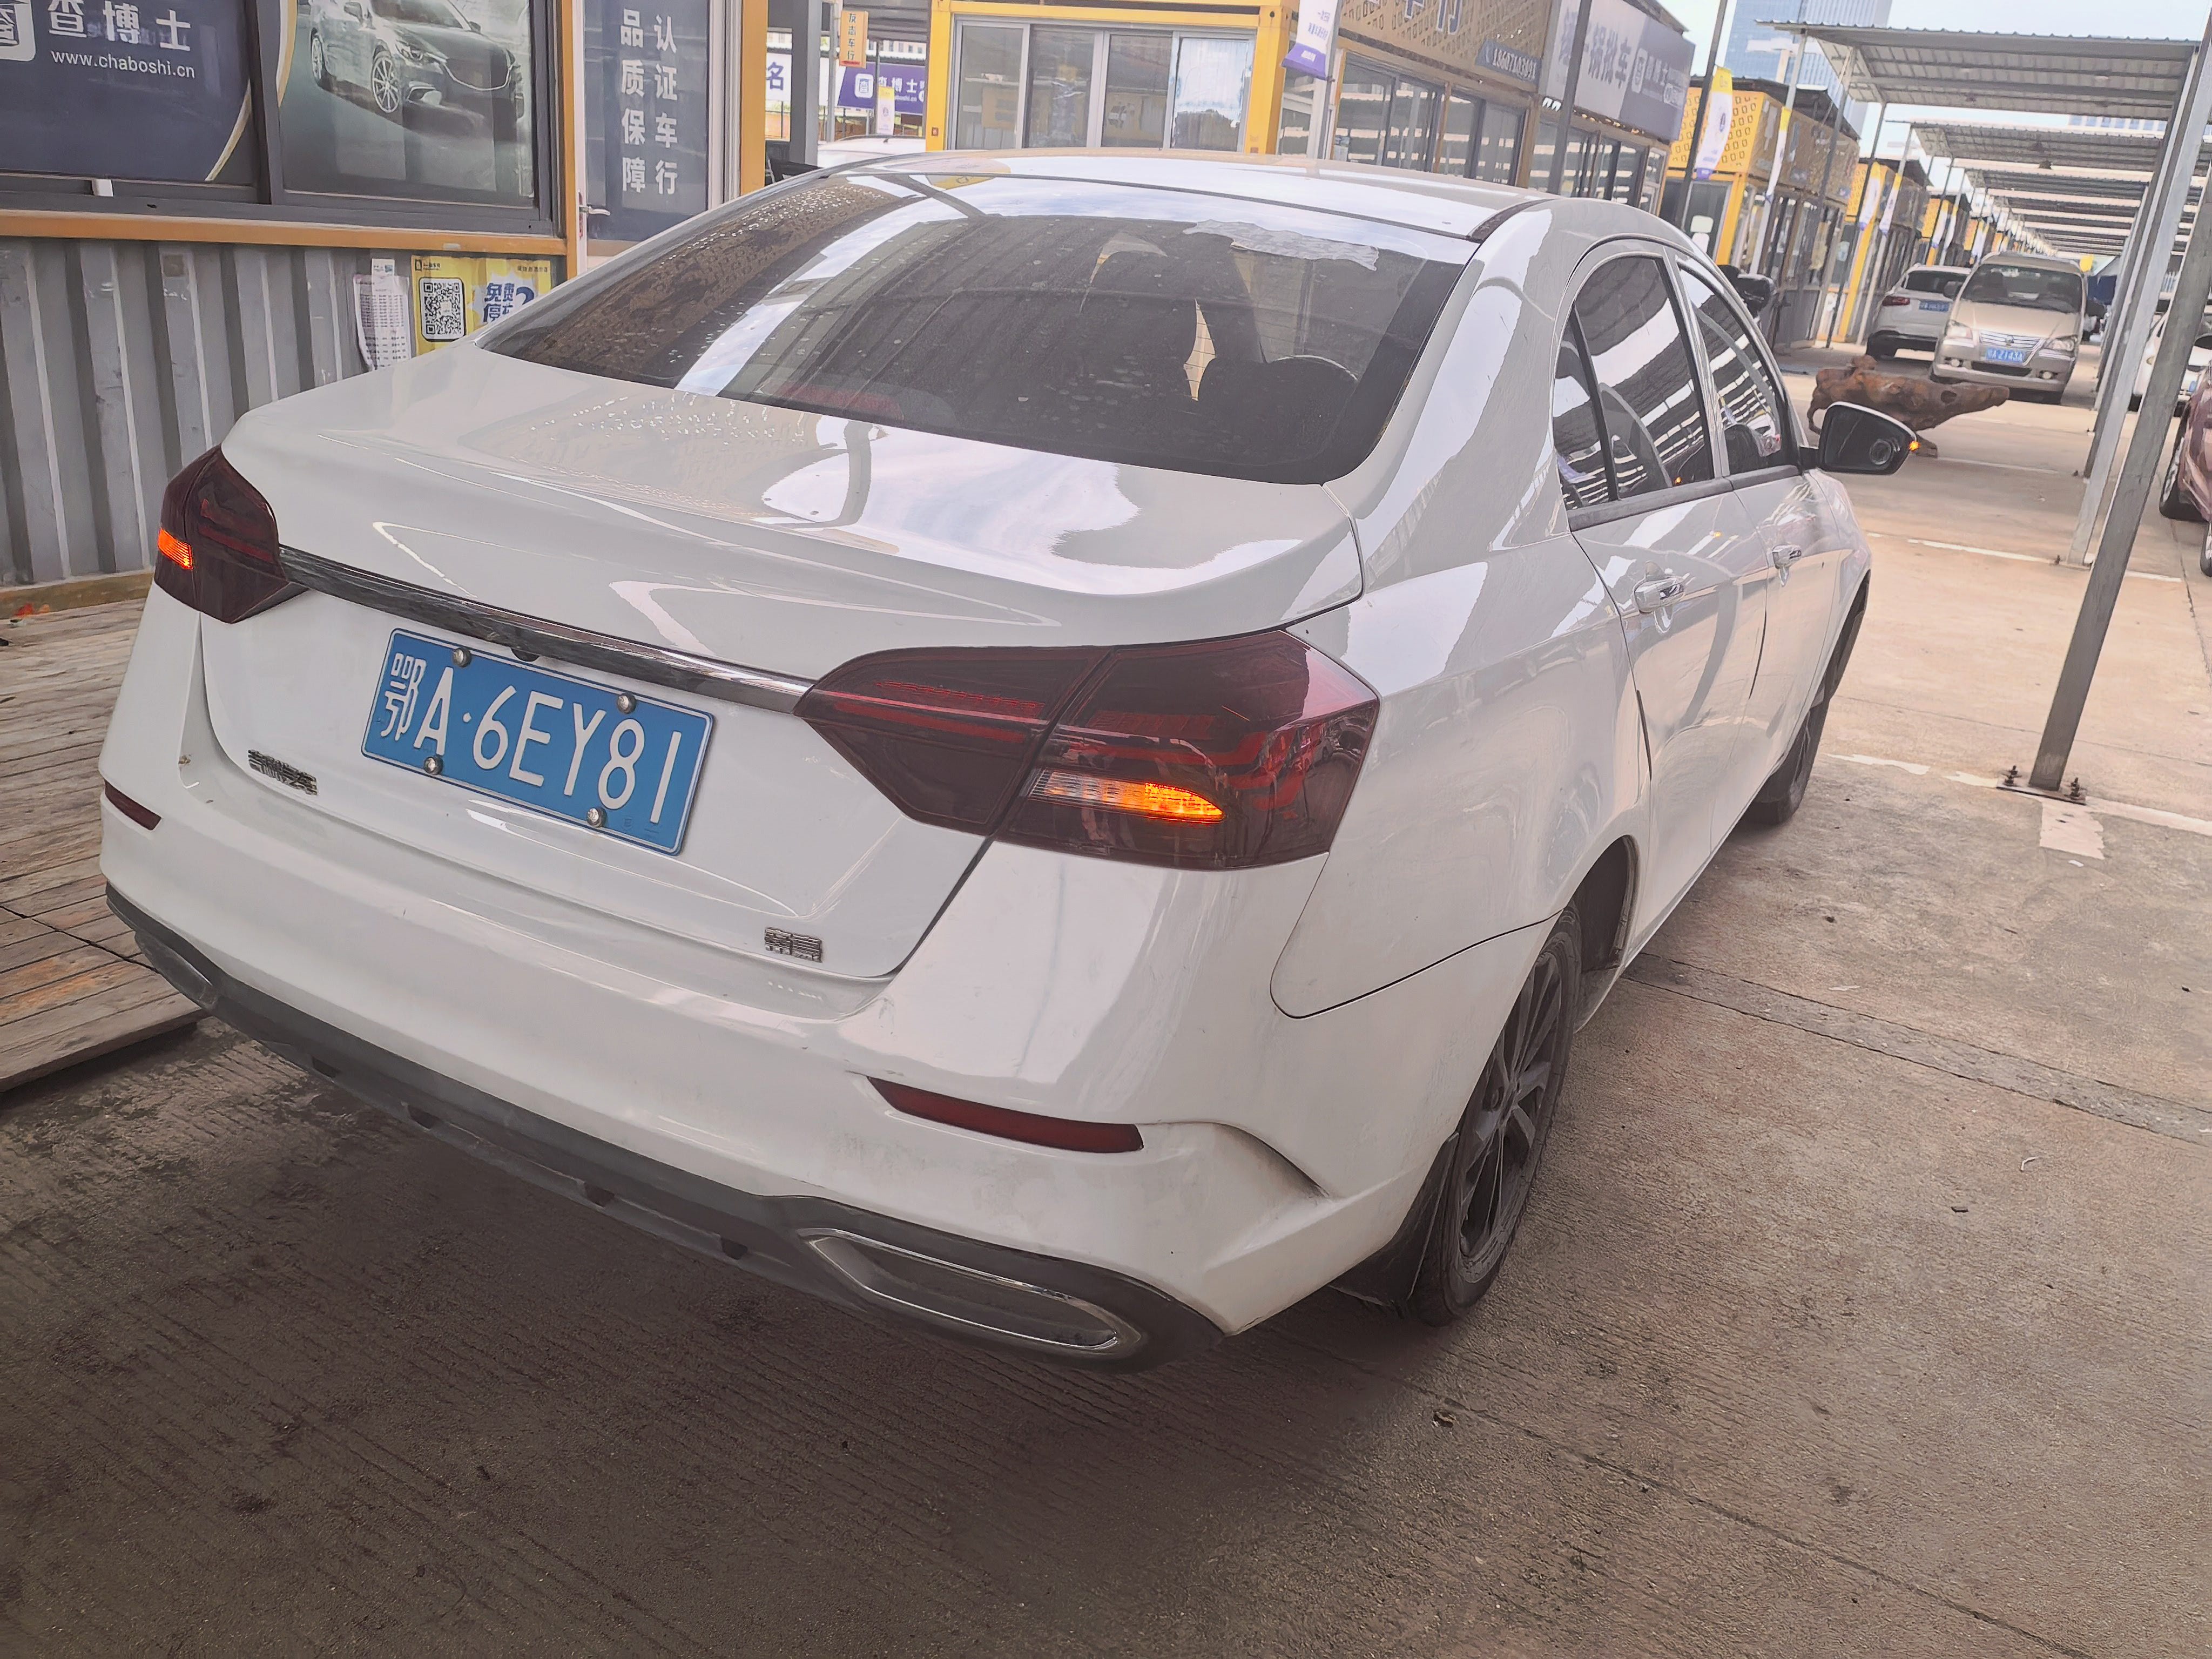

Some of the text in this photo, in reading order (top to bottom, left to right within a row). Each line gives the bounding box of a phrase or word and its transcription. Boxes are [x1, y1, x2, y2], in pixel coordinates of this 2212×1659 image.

[48, 0, 191, 51] 查博士
[51, 50, 195, 79] www.chaboshi.cn
[621, 9, 646, 193] 品质保障
[654, 15, 678, 194] 认证车行
[484, 282, 515, 302] 免费
[380, 652, 683, 824] 鄂A·6EY81
